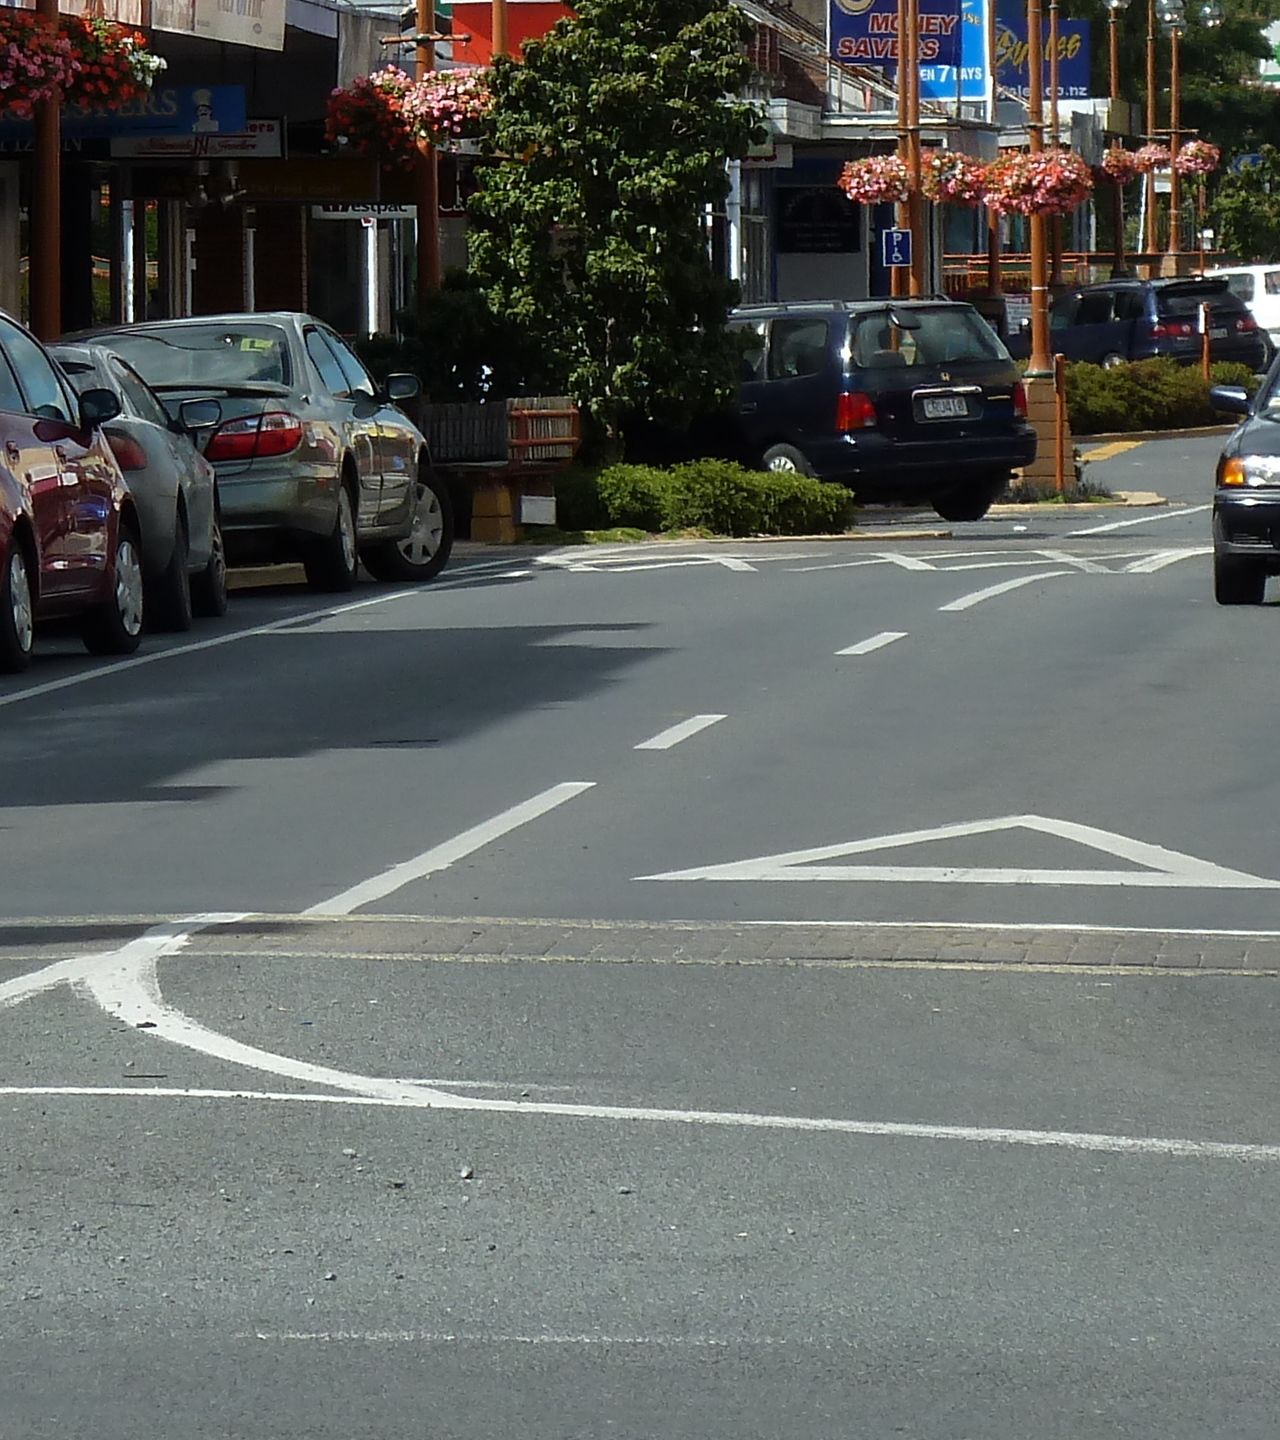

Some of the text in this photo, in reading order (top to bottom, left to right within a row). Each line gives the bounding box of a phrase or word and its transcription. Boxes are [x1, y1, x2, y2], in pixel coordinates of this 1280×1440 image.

[837, 36, 940, 60] SAVES
[937, 65, 951, 83] 7
[892, 232, 903, 246] P
